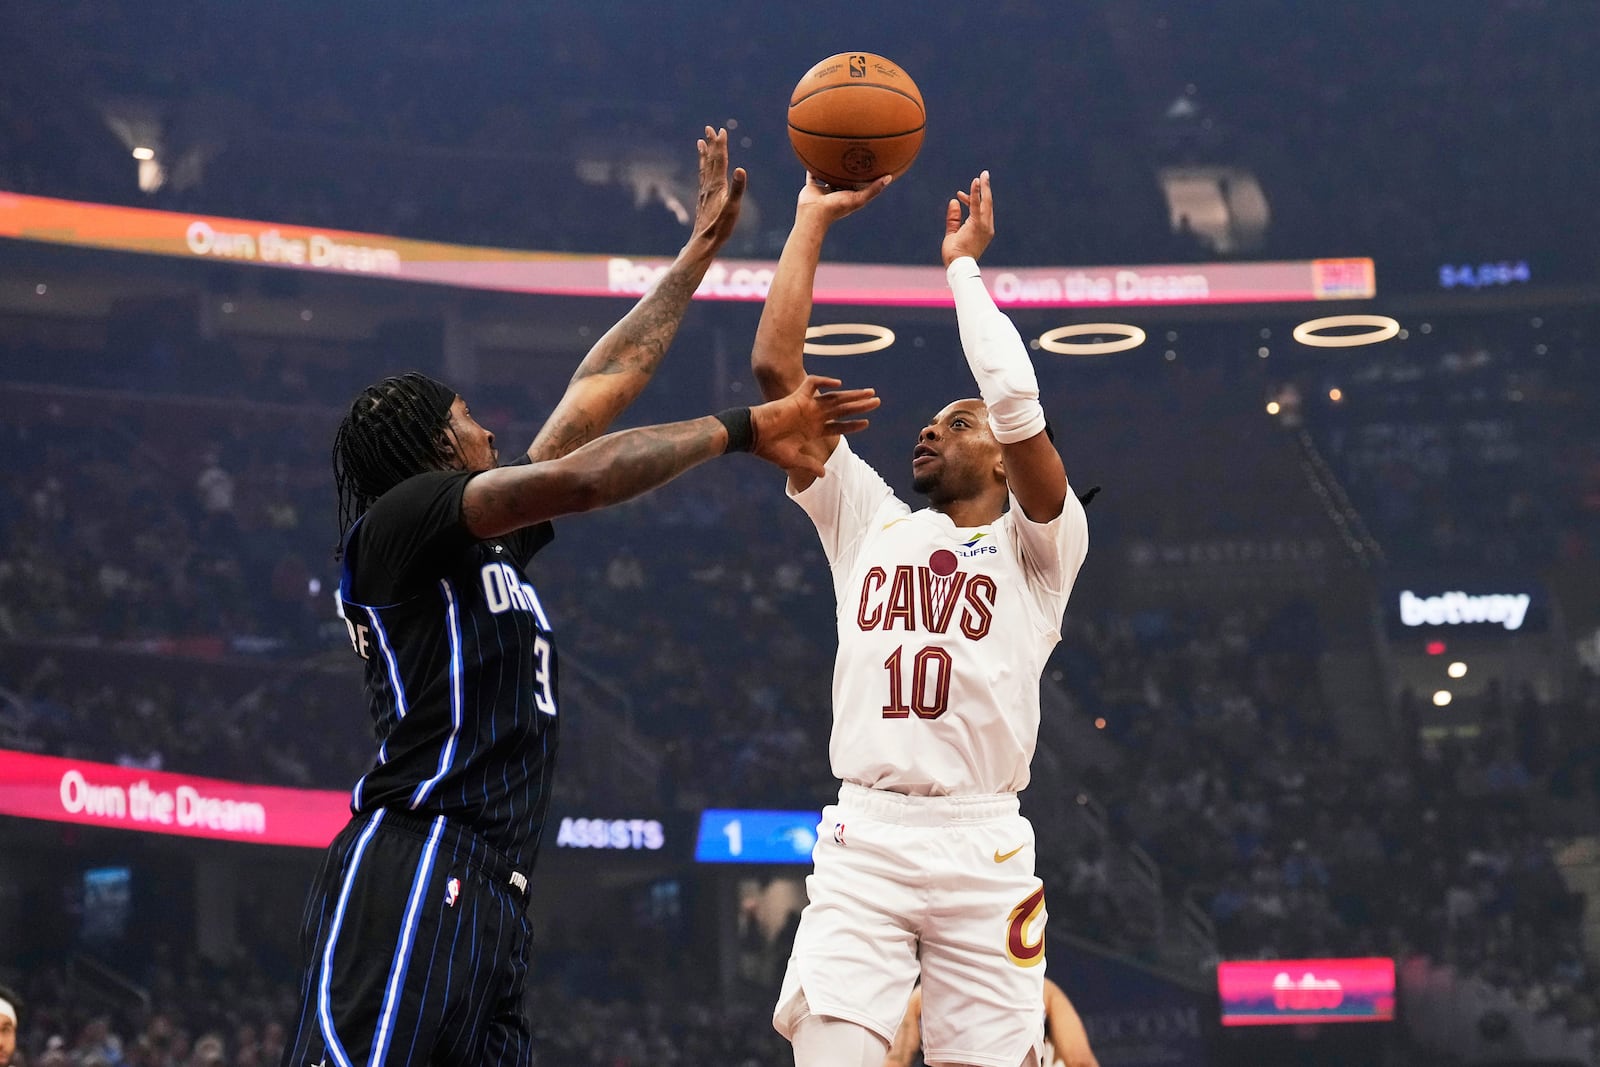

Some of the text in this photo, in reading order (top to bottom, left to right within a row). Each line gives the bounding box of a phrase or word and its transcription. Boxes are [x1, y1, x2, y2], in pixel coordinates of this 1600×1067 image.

[186, 221, 401, 273] Own the Dream
[994, 271, 1209, 303] Own the Dream
[955, 545, 998, 558] LIFFS
[857, 565, 997, 642] CAVS
[1399, 589, 1531, 631] betway
[532, 635, 558, 717] 3
[882, 644, 953, 720] 10
[60, 769, 265, 834] Own the Dream
[556, 816, 665, 849] ASSISTS
[722, 819, 743, 857] 1
